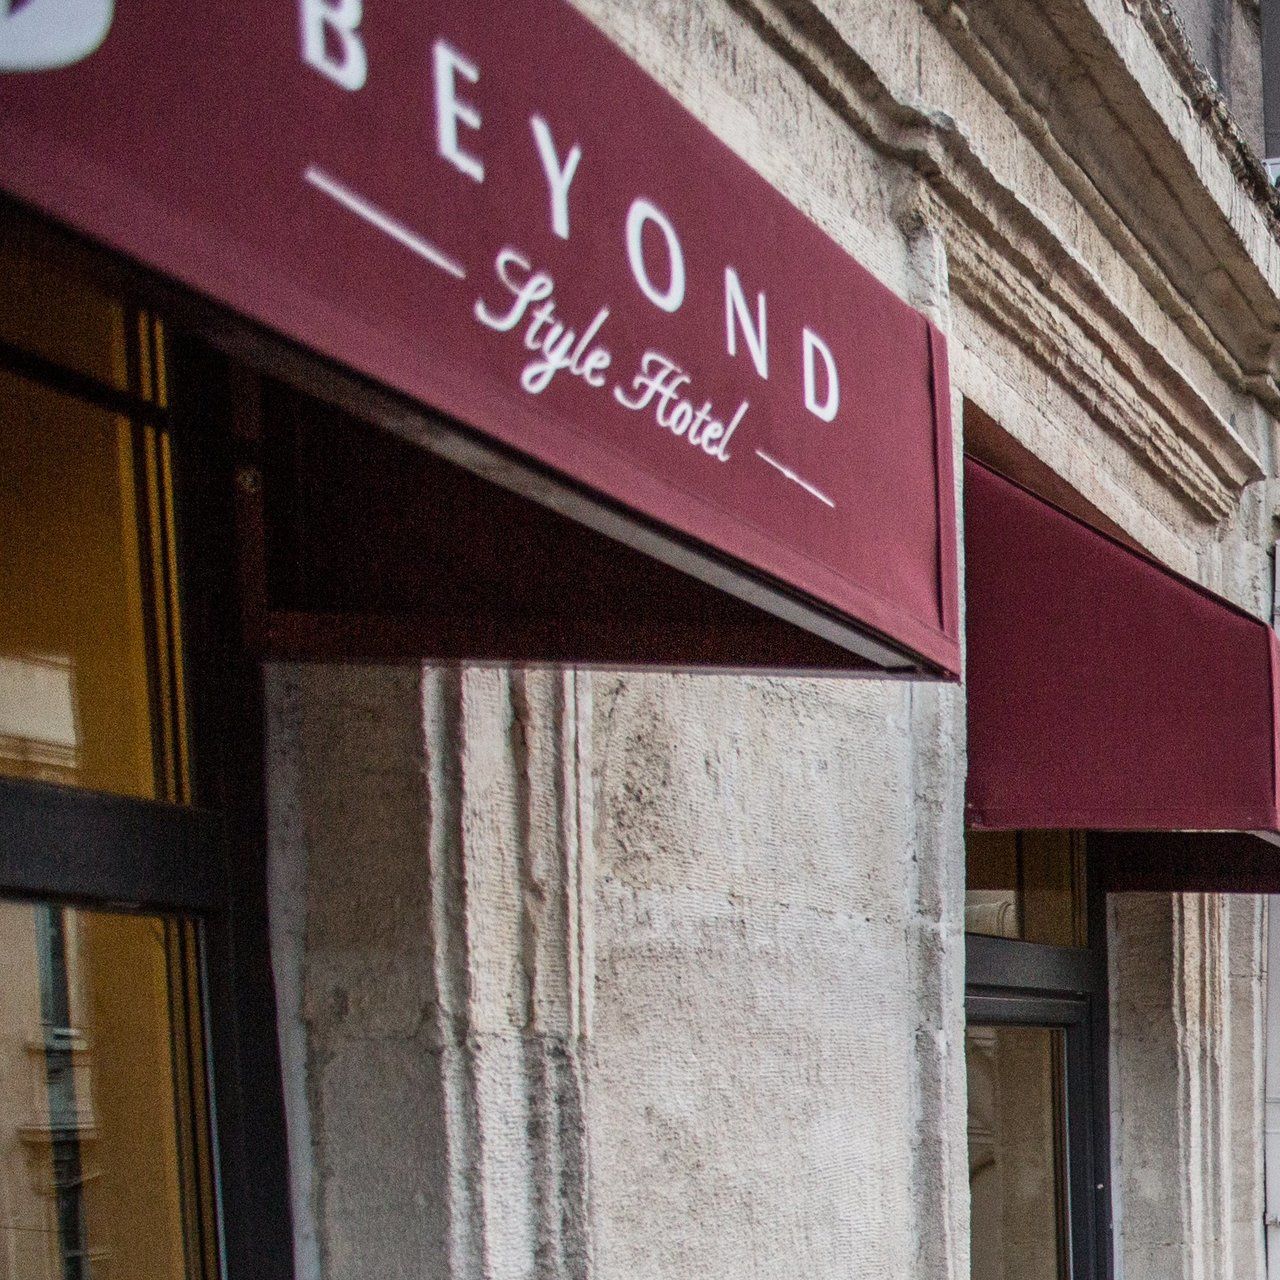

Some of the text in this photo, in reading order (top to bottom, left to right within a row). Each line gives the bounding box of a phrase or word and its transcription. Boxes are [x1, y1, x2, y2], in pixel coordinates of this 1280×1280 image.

[300, 0, 839, 423] BEYOND
[474, 247, 749, 463] Style Hotel
